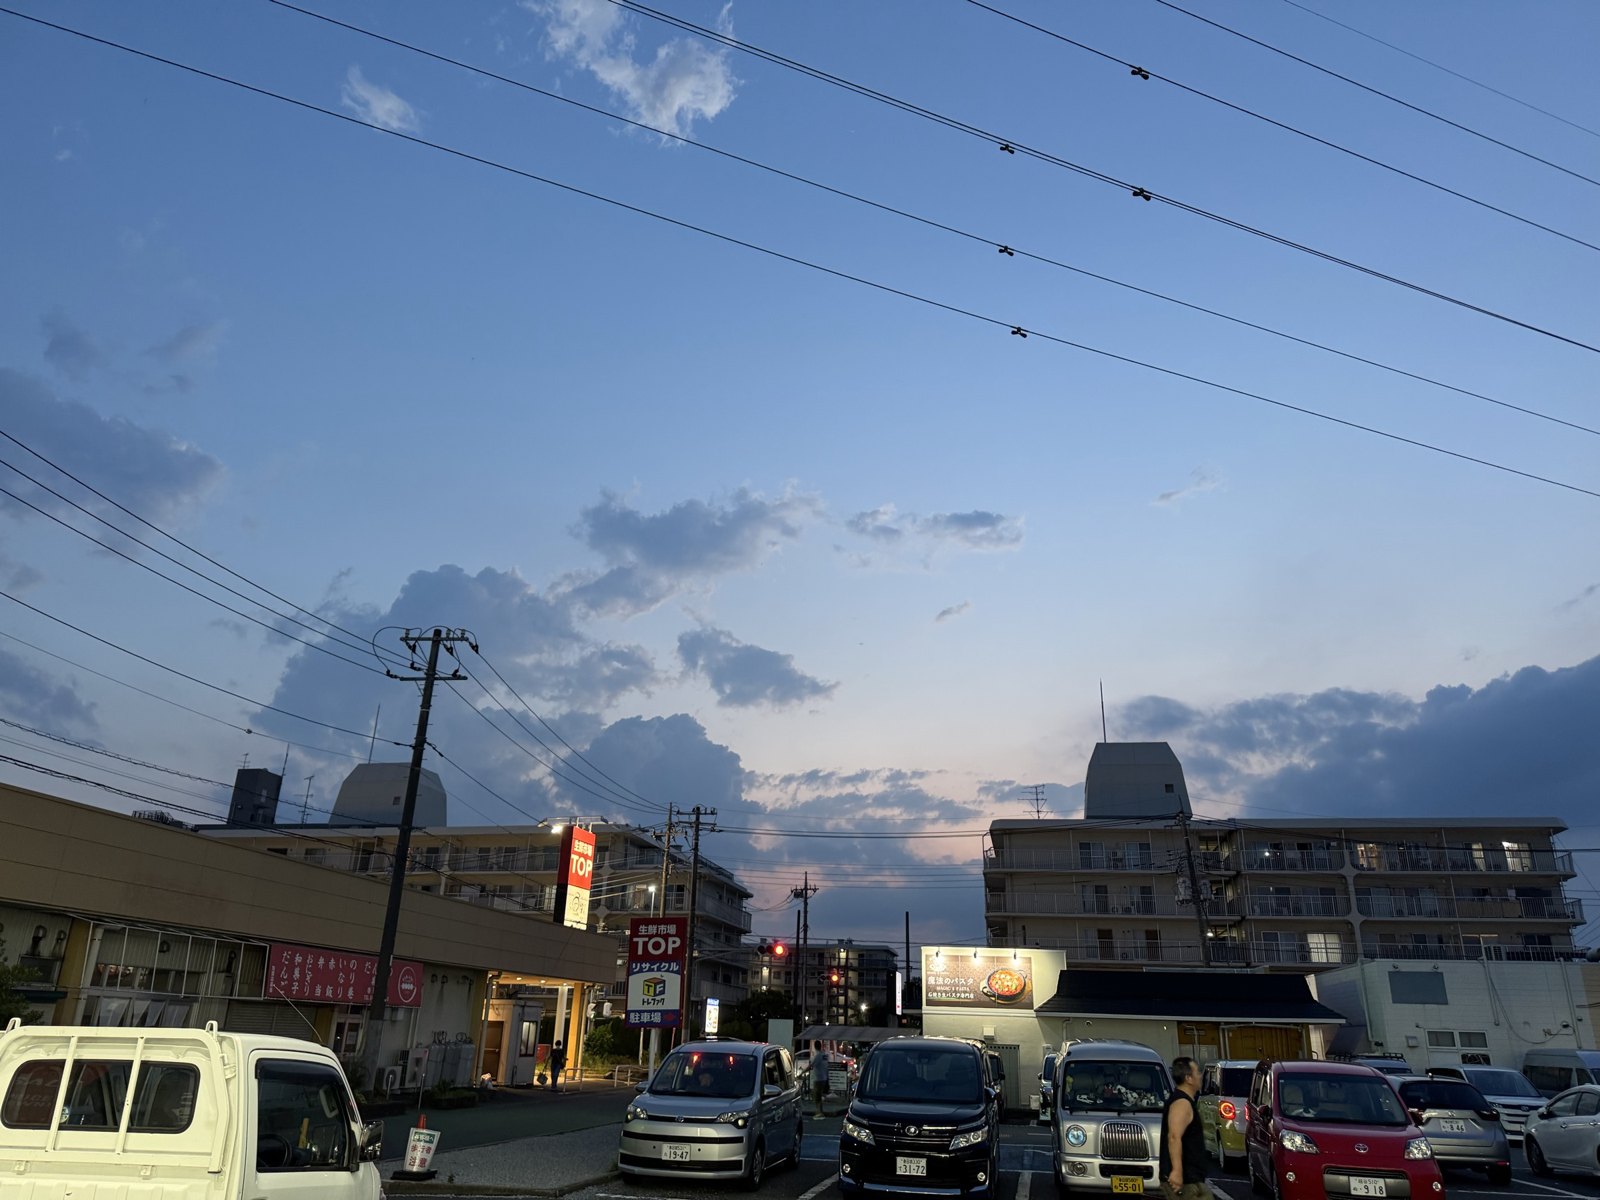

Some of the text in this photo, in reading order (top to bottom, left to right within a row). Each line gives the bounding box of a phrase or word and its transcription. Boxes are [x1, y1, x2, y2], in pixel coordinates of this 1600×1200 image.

[571, 854, 592, 878] TOP
[638, 924, 676, 935] 生鮮市場
[633, 937, 681, 955] TOP
[632, 962, 679, 972] リサイクル
[303, 953, 314, 996] おにぎり
[337, 958, 347, 998] いなり
[928, 976, 974, 985] 魔法のパスタ
[642, 998, 665, 1006] トレファク
[629, 1012, 661, 1023] 駐車場
[411, 1144, 432, 1154] 歩行者
[669, 1150, 689, 1160] 19-47
[409, 1155, 427, 1168] 注意
[903, 1164, 925, 1174] 31-72
[1118, 1183, 1141, 1192] 55-01
